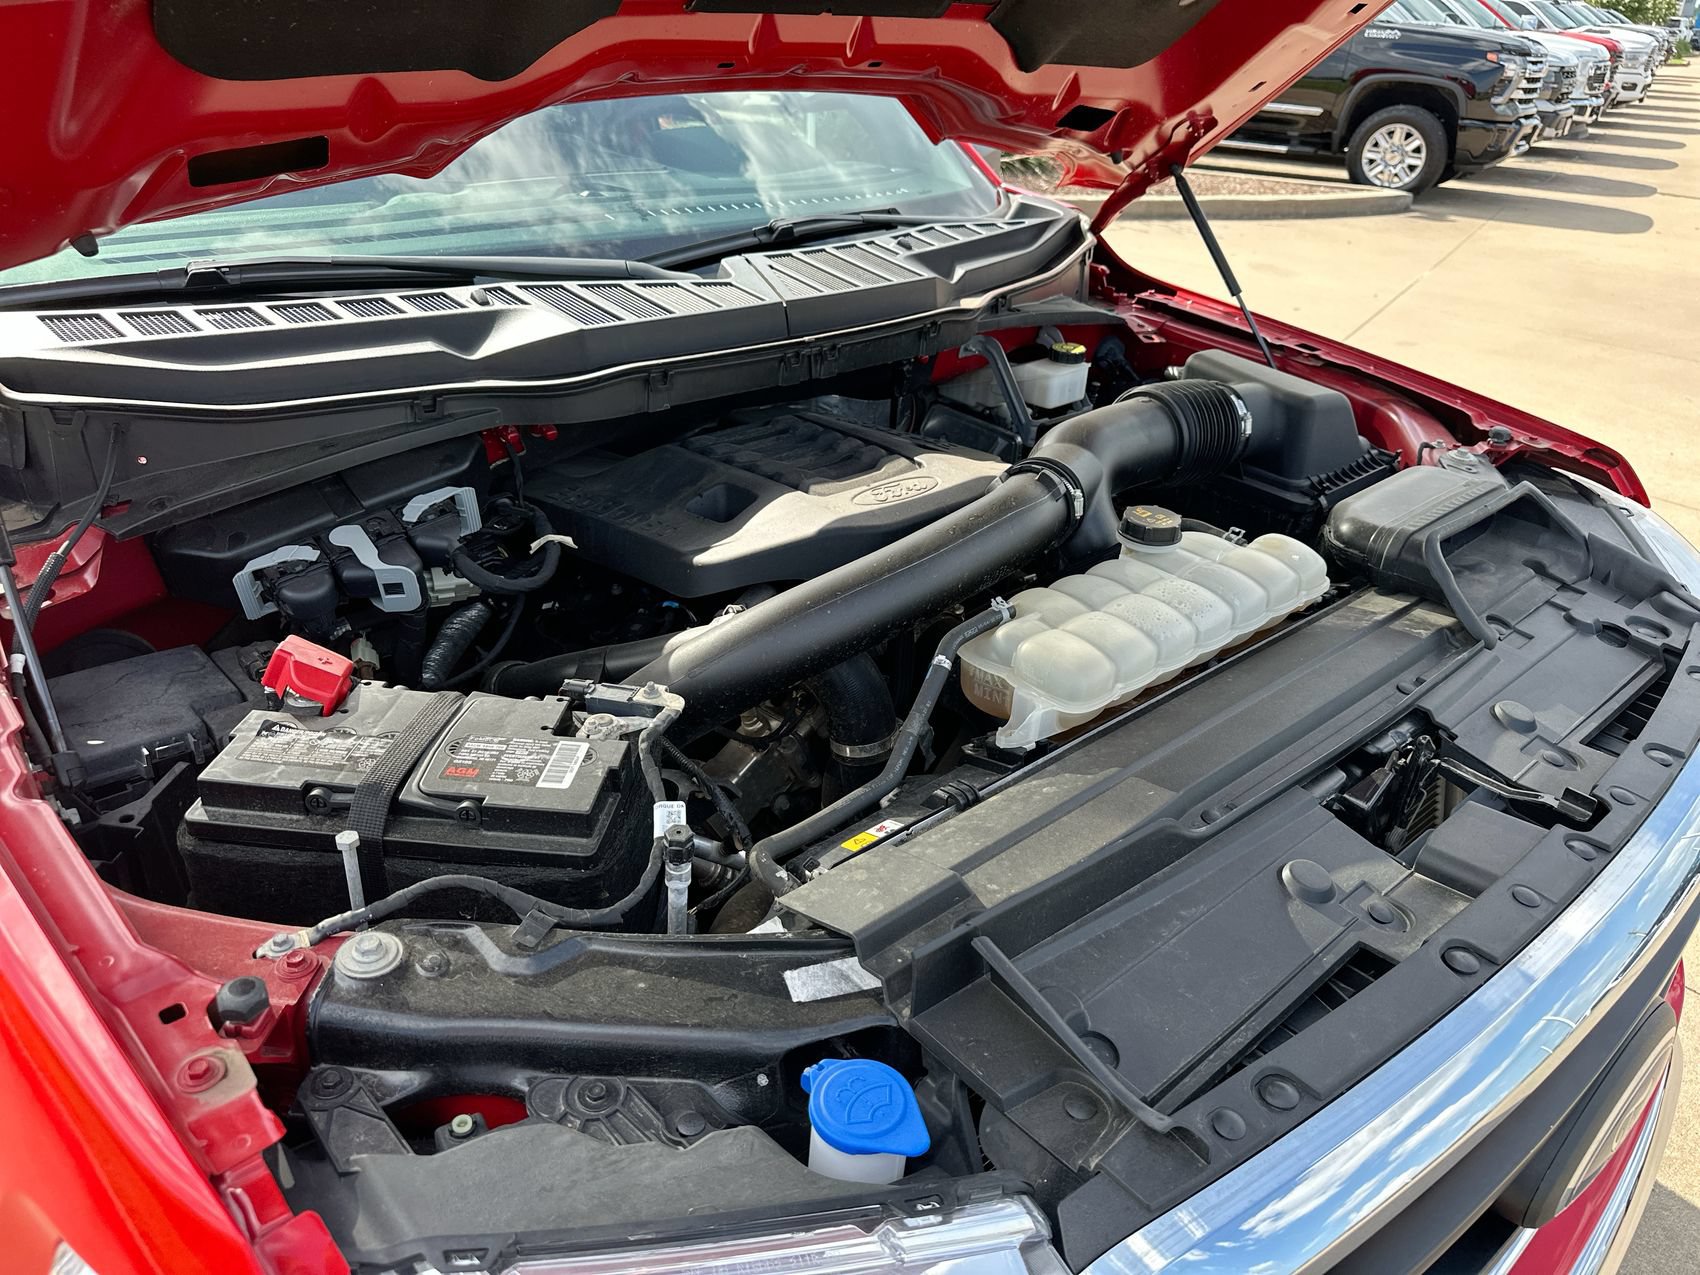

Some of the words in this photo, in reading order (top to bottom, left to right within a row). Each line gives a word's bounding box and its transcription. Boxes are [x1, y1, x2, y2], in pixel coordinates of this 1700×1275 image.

[871, 483, 928, 502] Ford
[974, 669, 1003, 688] MAX
[974, 683, 1000, 704] MIN
[446, 767, 479, 776] AGM
